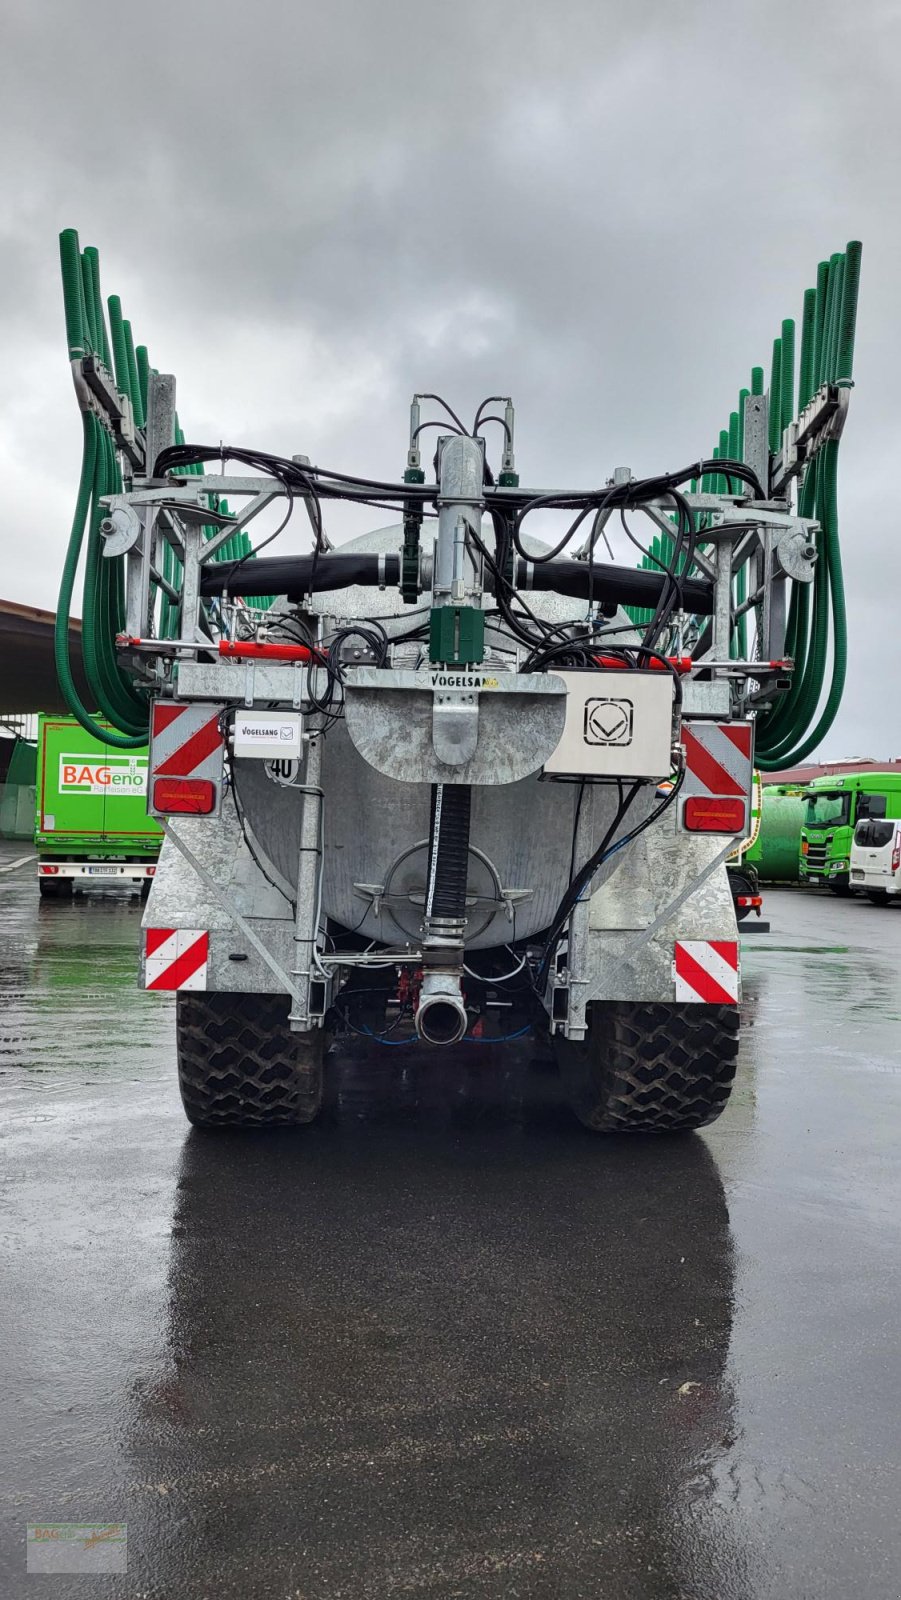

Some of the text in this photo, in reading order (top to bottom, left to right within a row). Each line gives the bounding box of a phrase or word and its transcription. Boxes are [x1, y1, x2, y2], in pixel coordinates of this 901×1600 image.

[242, 727, 278, 736] VOGELSANG
[63, 766, 144, 786] BAGeno
[271, 760, 292, 778] 40
